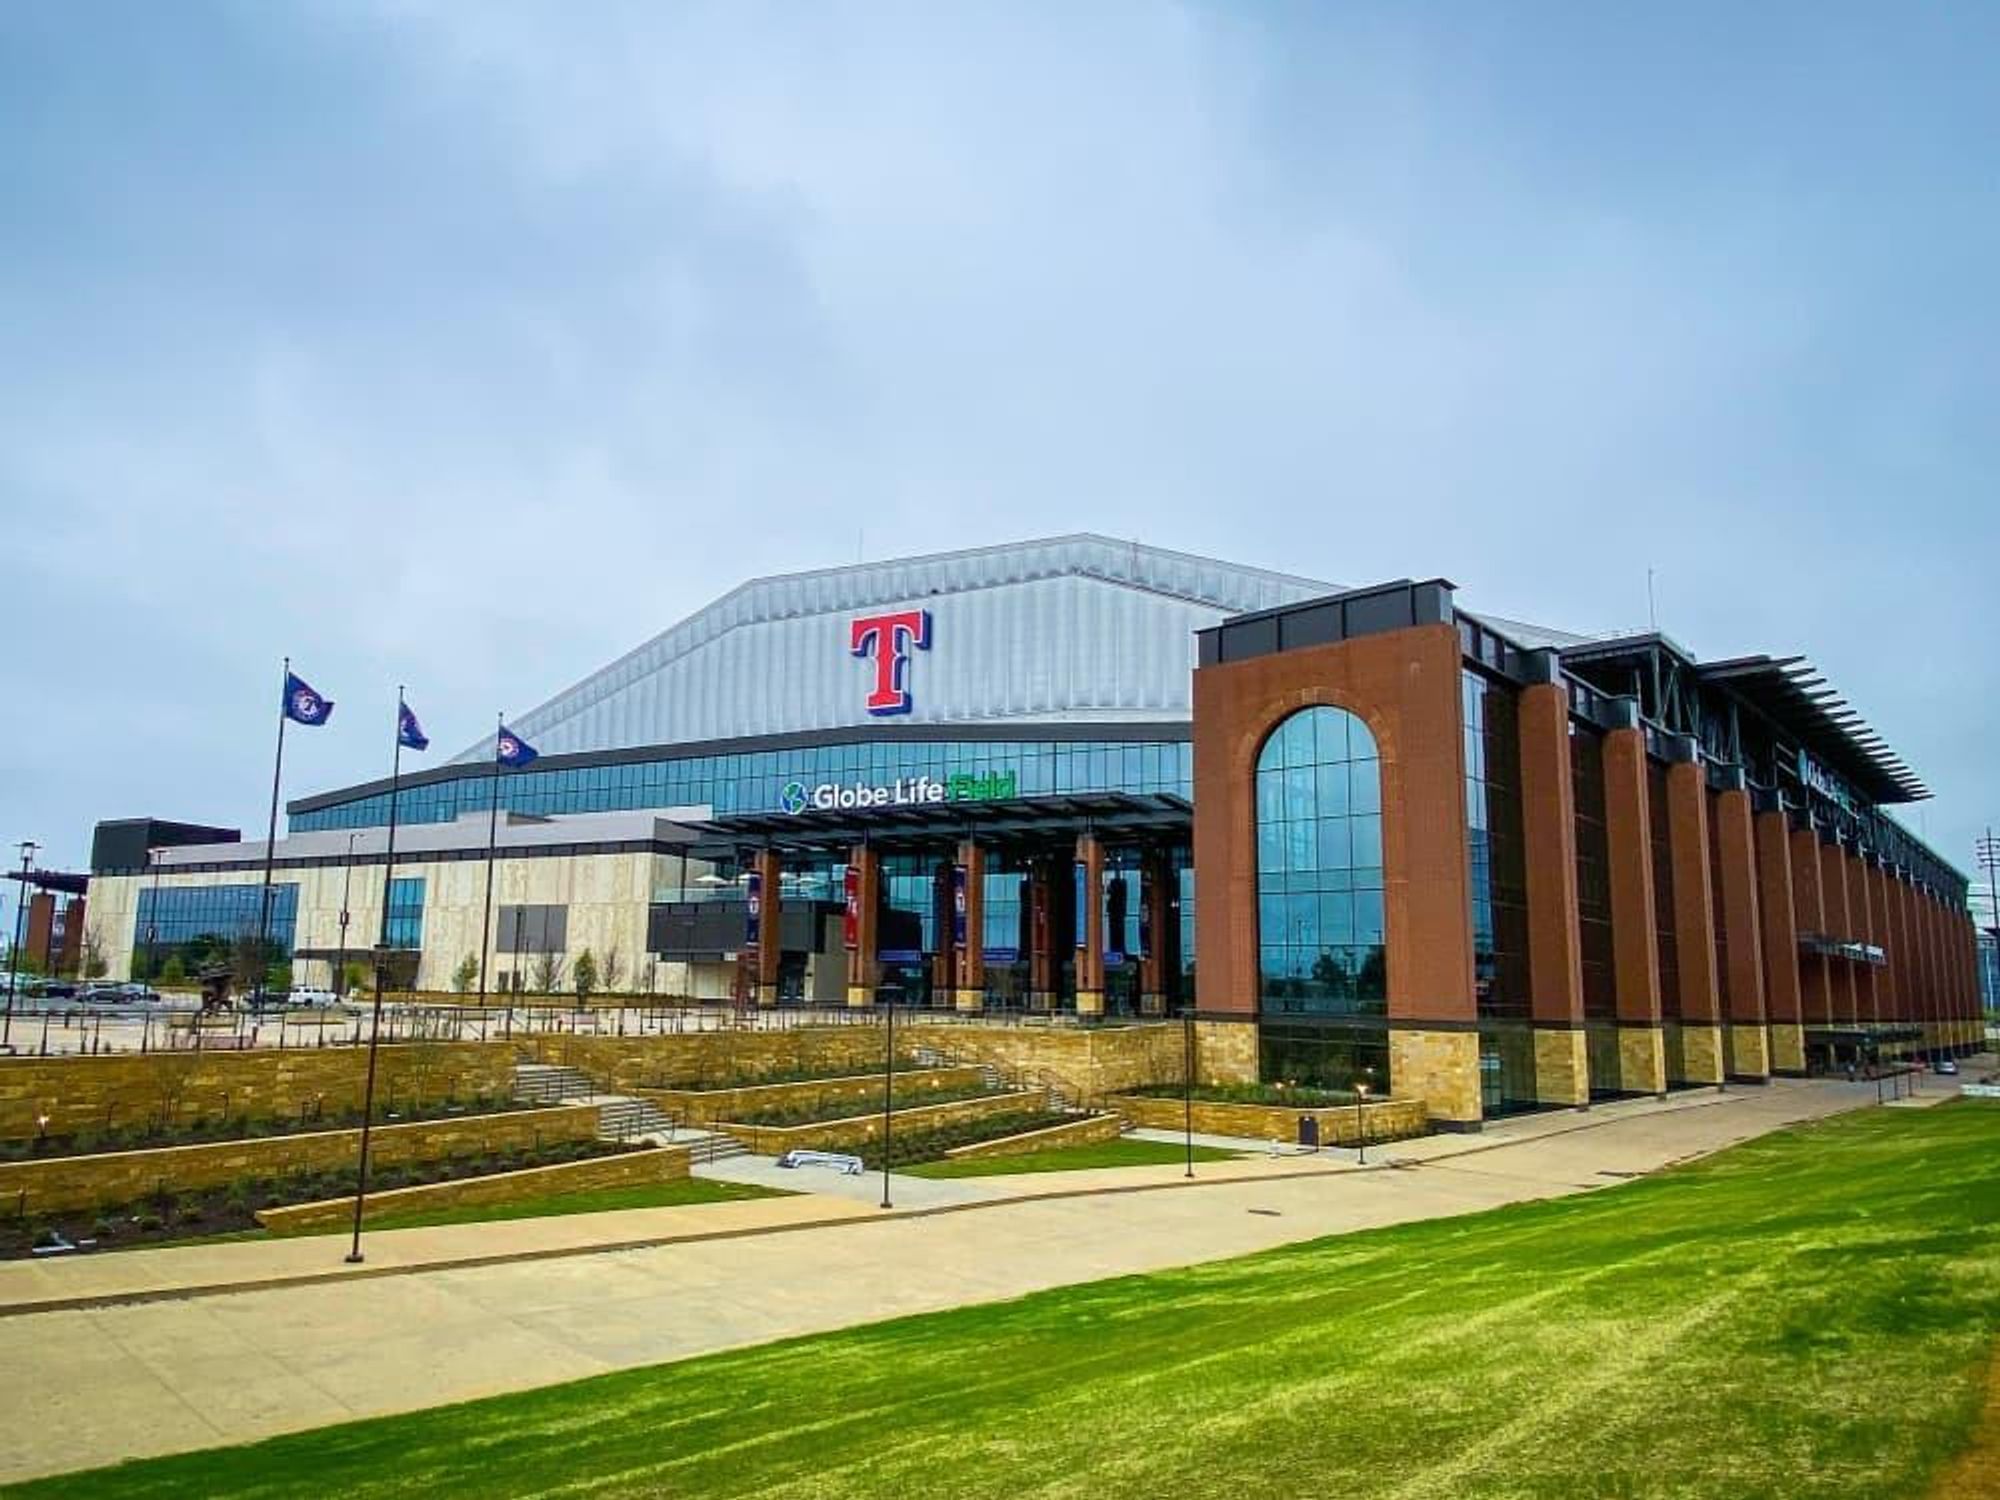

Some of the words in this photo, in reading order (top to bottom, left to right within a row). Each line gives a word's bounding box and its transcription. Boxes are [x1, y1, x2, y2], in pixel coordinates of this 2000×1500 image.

[849, 608, 932, 717] T
[814, 782, 888, 809] Globe
[895, 776, 944, 804] Life
